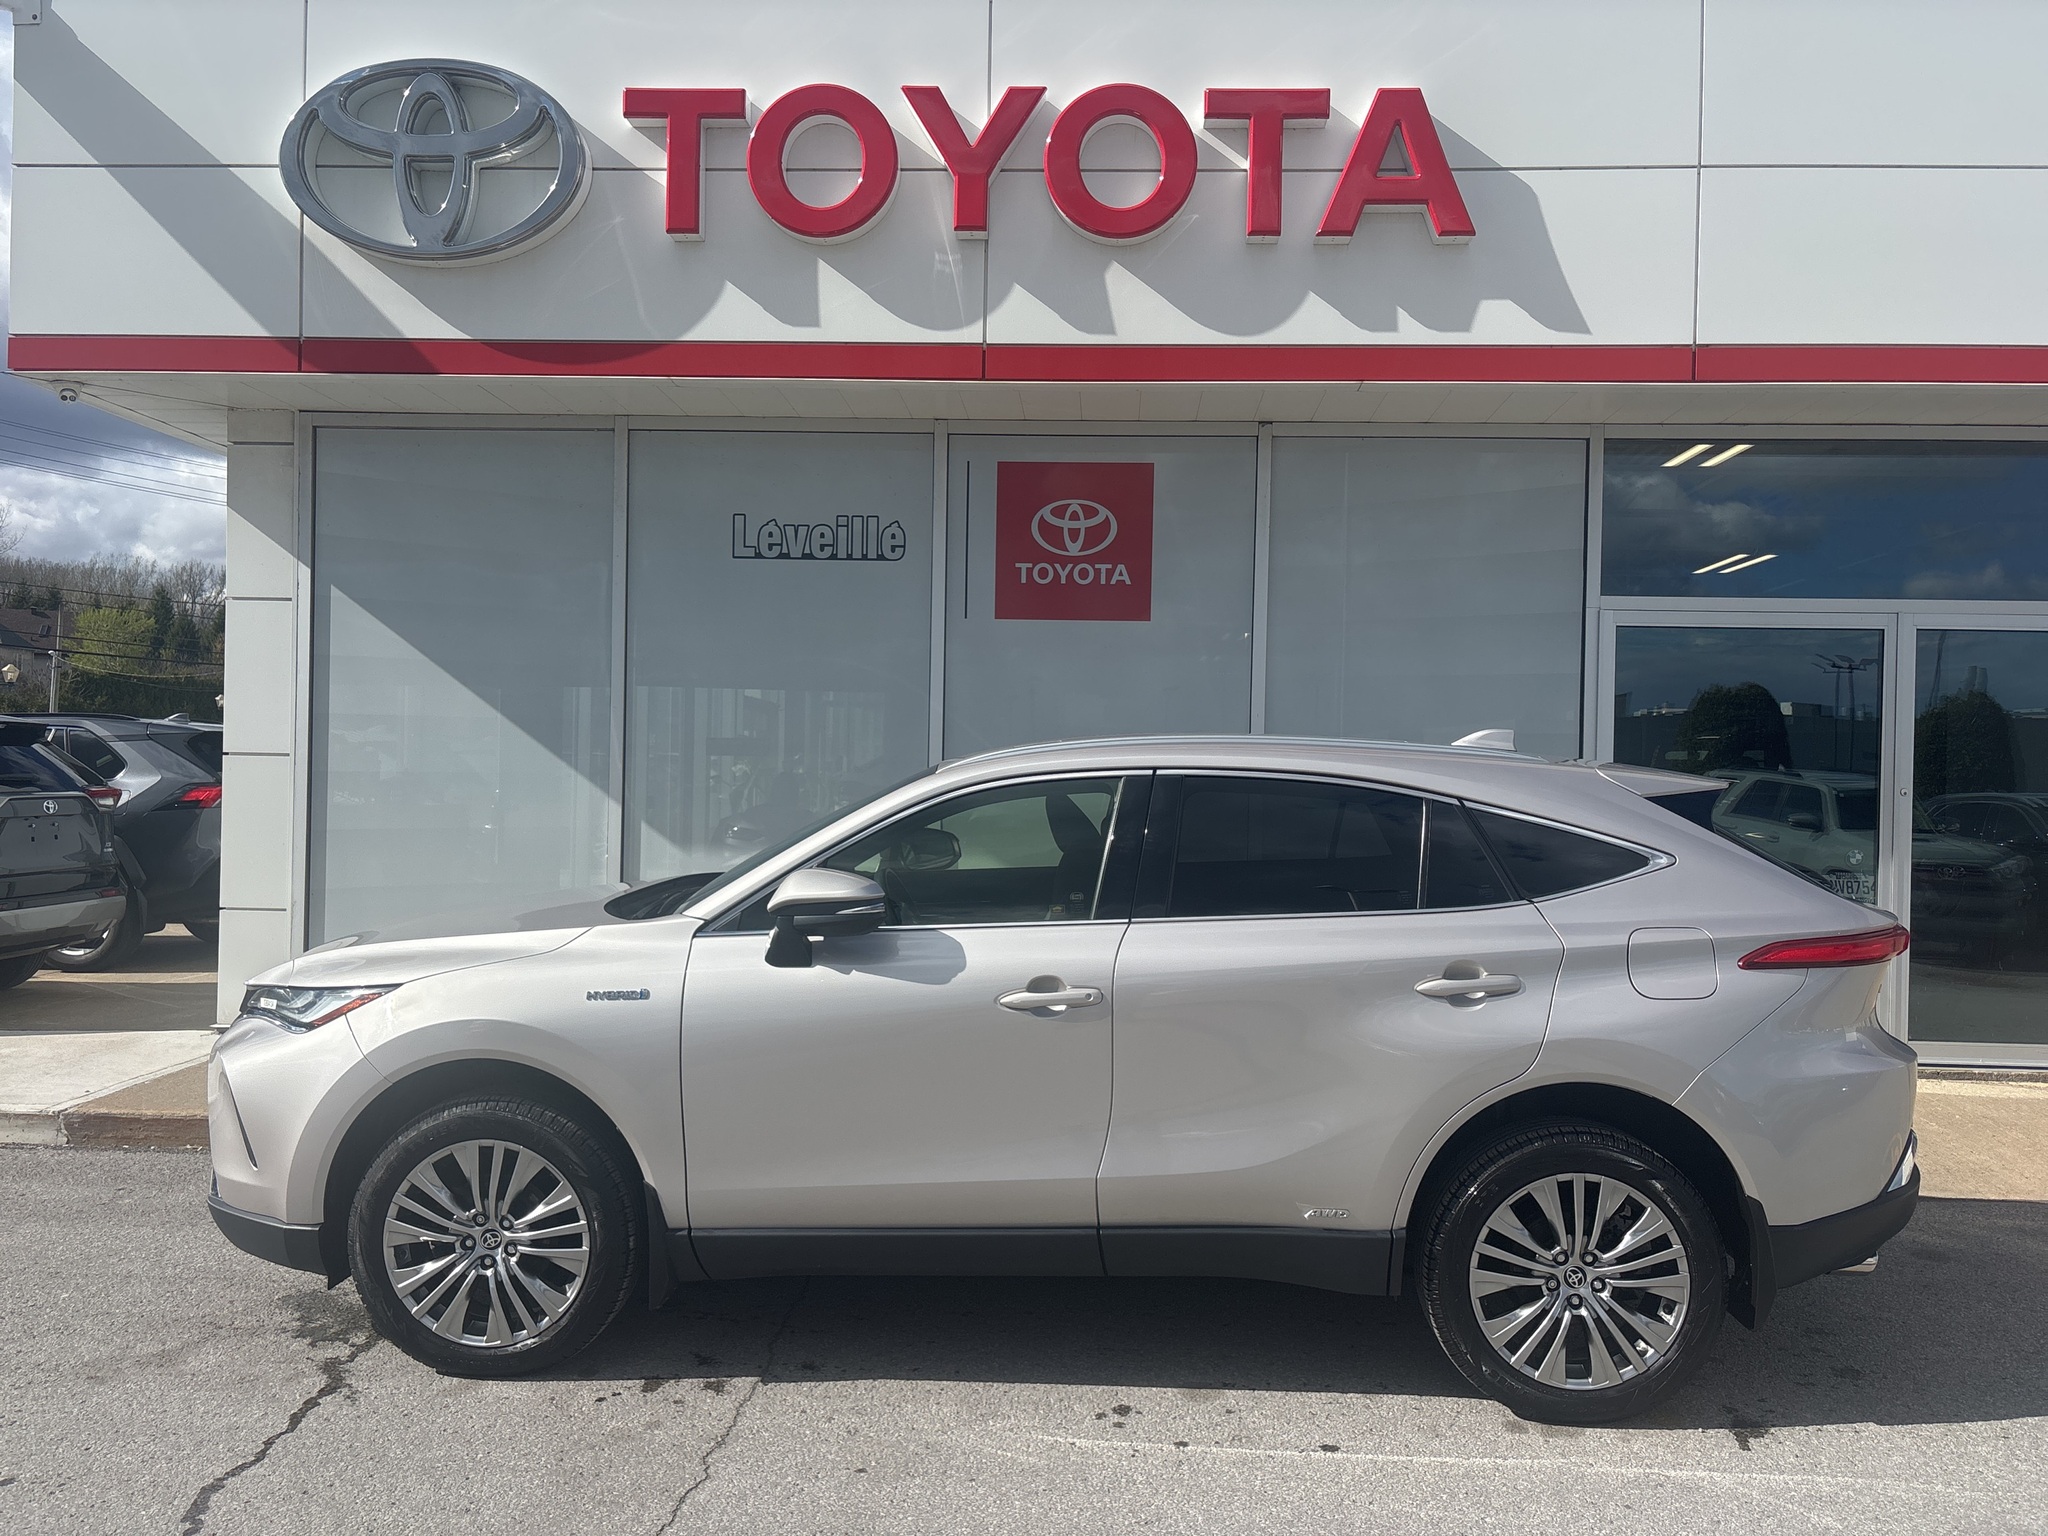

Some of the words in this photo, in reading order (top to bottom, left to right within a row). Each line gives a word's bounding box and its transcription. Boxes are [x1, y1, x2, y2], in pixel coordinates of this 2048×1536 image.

[623, 84, 1476, 244] TOYOTA
[732, 514, 906, 561] Léveillé
[1015, 562, 1132, 585] TOYOTA
[585, 988, 643, 1001] HYBRID
